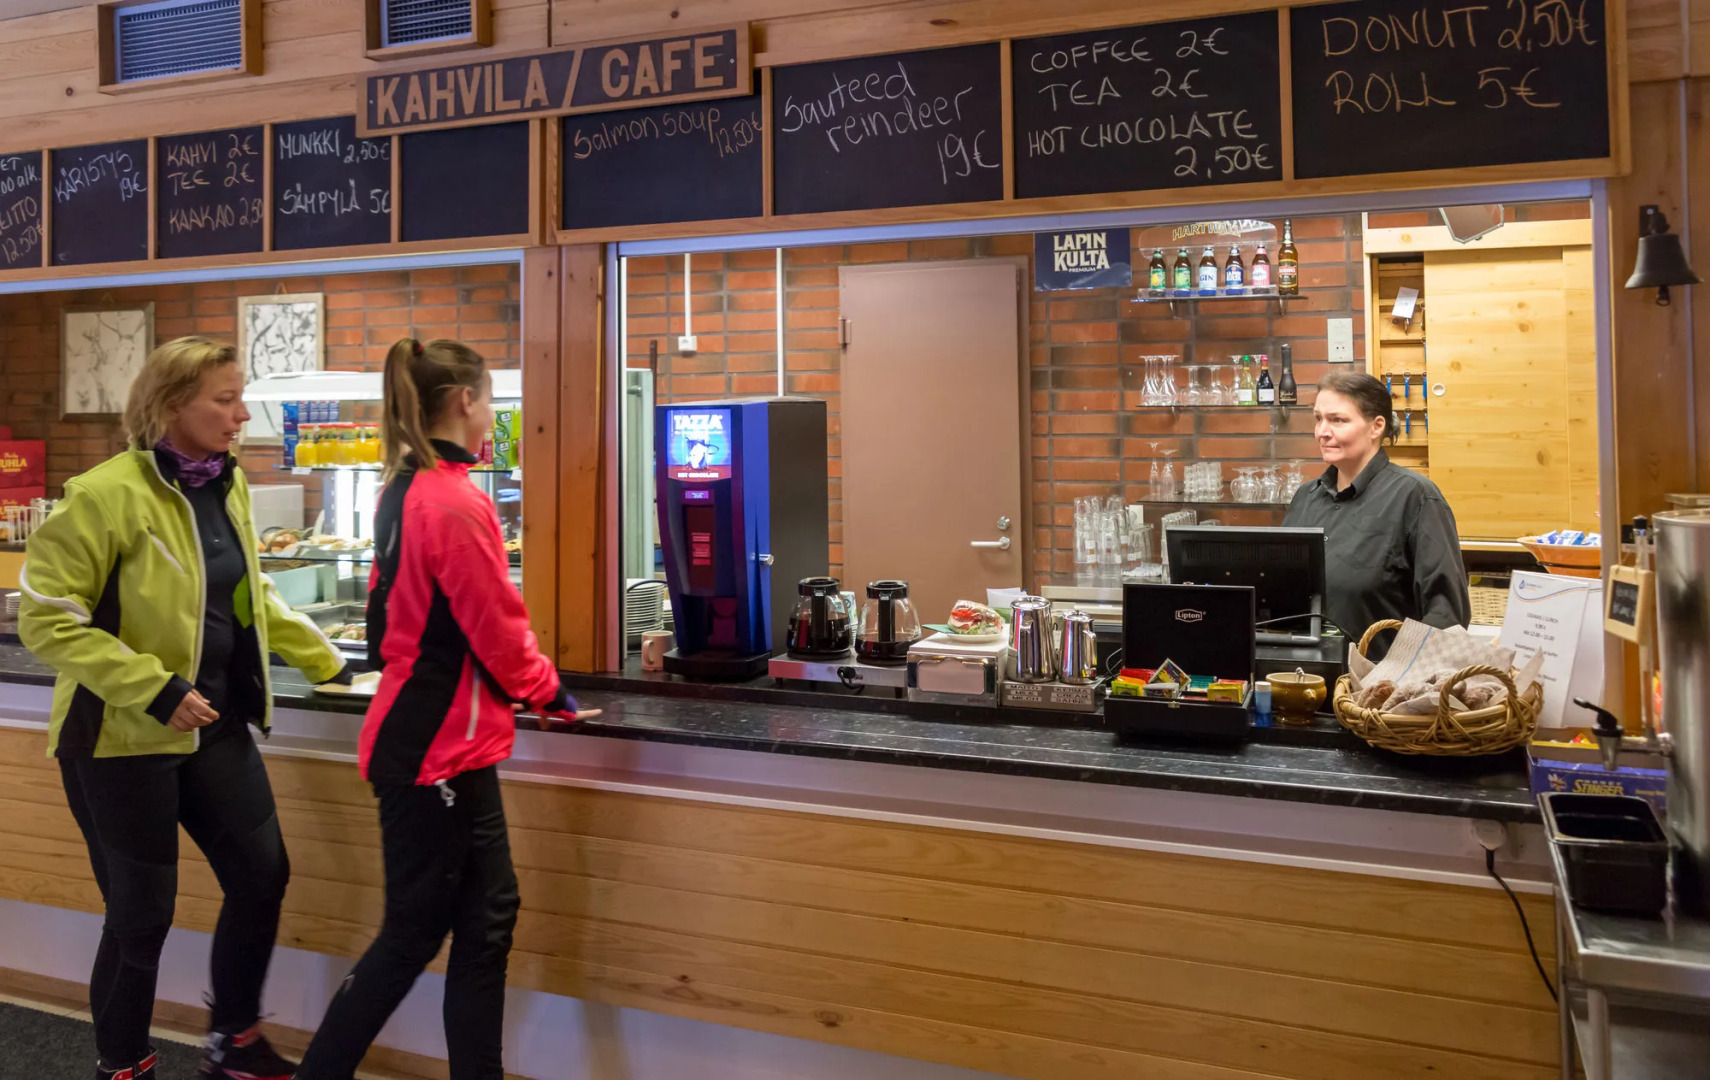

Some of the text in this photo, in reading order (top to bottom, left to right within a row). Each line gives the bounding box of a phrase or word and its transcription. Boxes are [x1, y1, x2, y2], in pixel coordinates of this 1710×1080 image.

[1322, 0, 1597, 56] DONUT 2,50€
[1030, 28, 1230, 73] COFFEE 2€
[376, 59, 550, 126] KAHVILA
[601, 35, 724, 99] CAFE
[1038, 69, 1208, 112] TEA 2€
[1325, 67, 1561, 114] ROLL 5€
[824, 86, 973, 153] reindeer
[1029, 109, 1259, 158] HOT CHOCOLATE
[167, 134, 259, 167] KAHVI 2€
[279, 128, 341, 161] MUNKKI
[938, 130, 1000, 185] 19€
[1174, 142, 1274, 180] 2,50€
[168, 162, 256, 195] TEE 2€
[1053, 232, 1107, 250] LAPIN
[1054, 249, 1111, 272] KULTA
[0, 458, 28, 468] UHLA
[1177, 611, 1201, 620] Lipton
